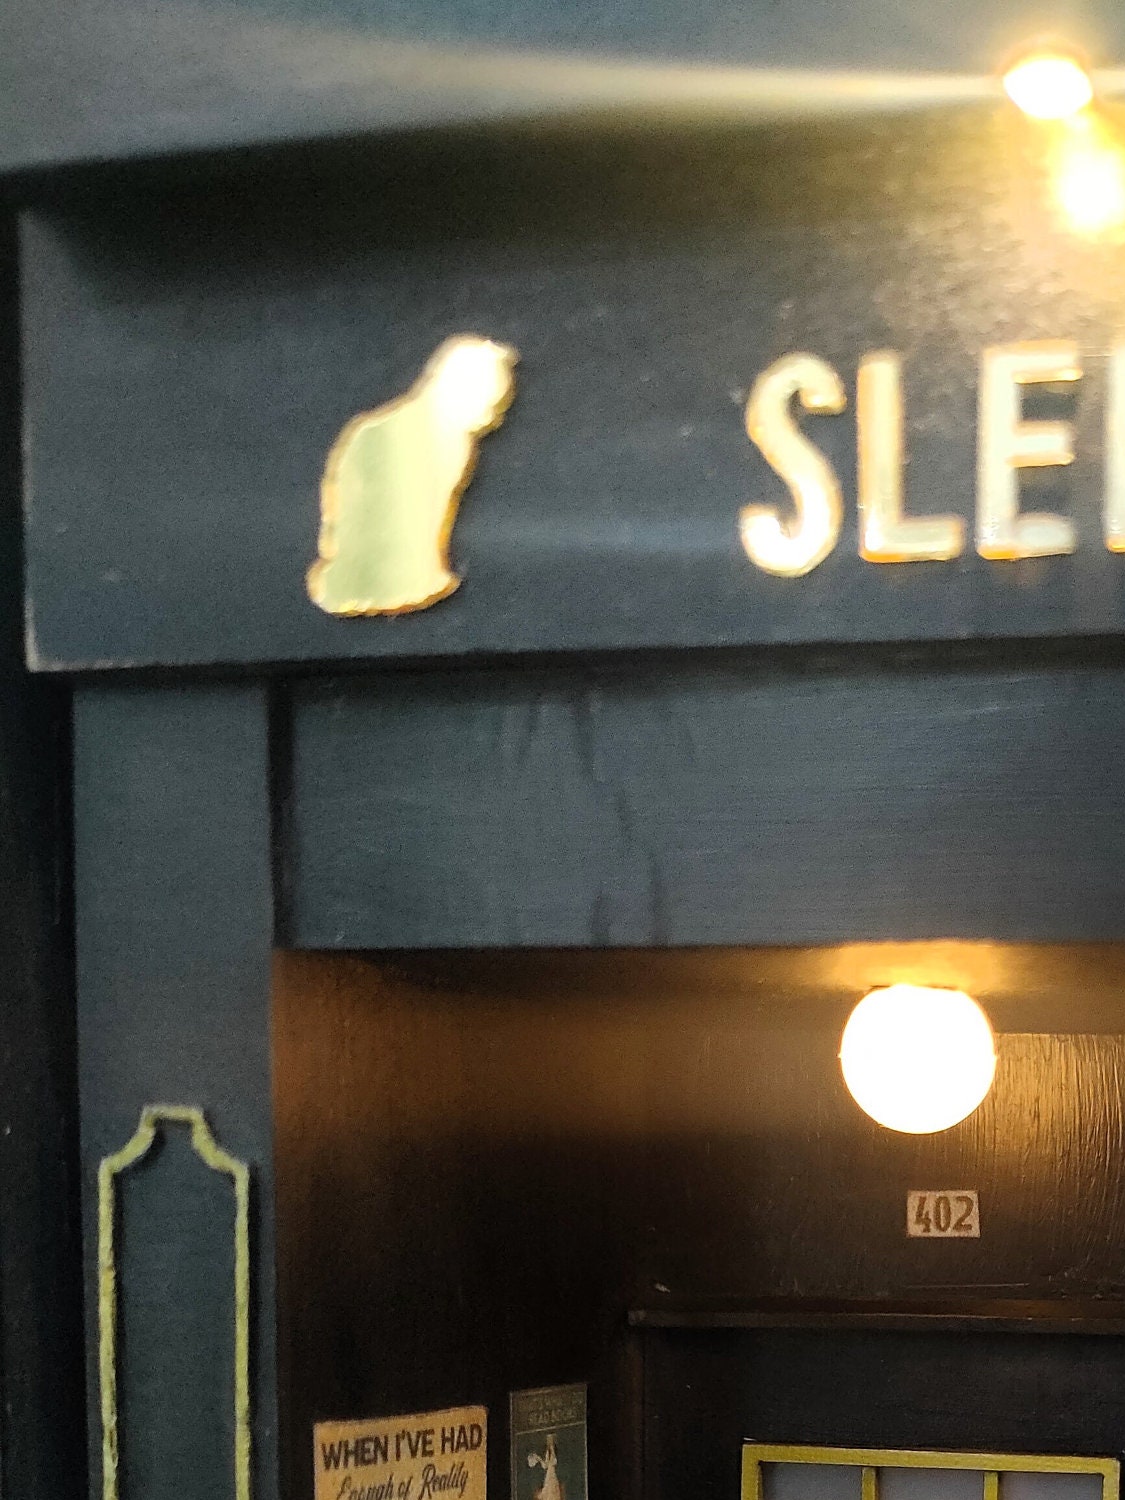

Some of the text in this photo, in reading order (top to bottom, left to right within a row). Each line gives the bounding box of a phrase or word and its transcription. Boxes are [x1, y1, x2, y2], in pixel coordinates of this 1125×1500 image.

[914, 1195, 974, 1233] 402
[321, 1423, 482, 1471] WHEN I'VE HAD
[418, 1461, 469, 1500] Reality
